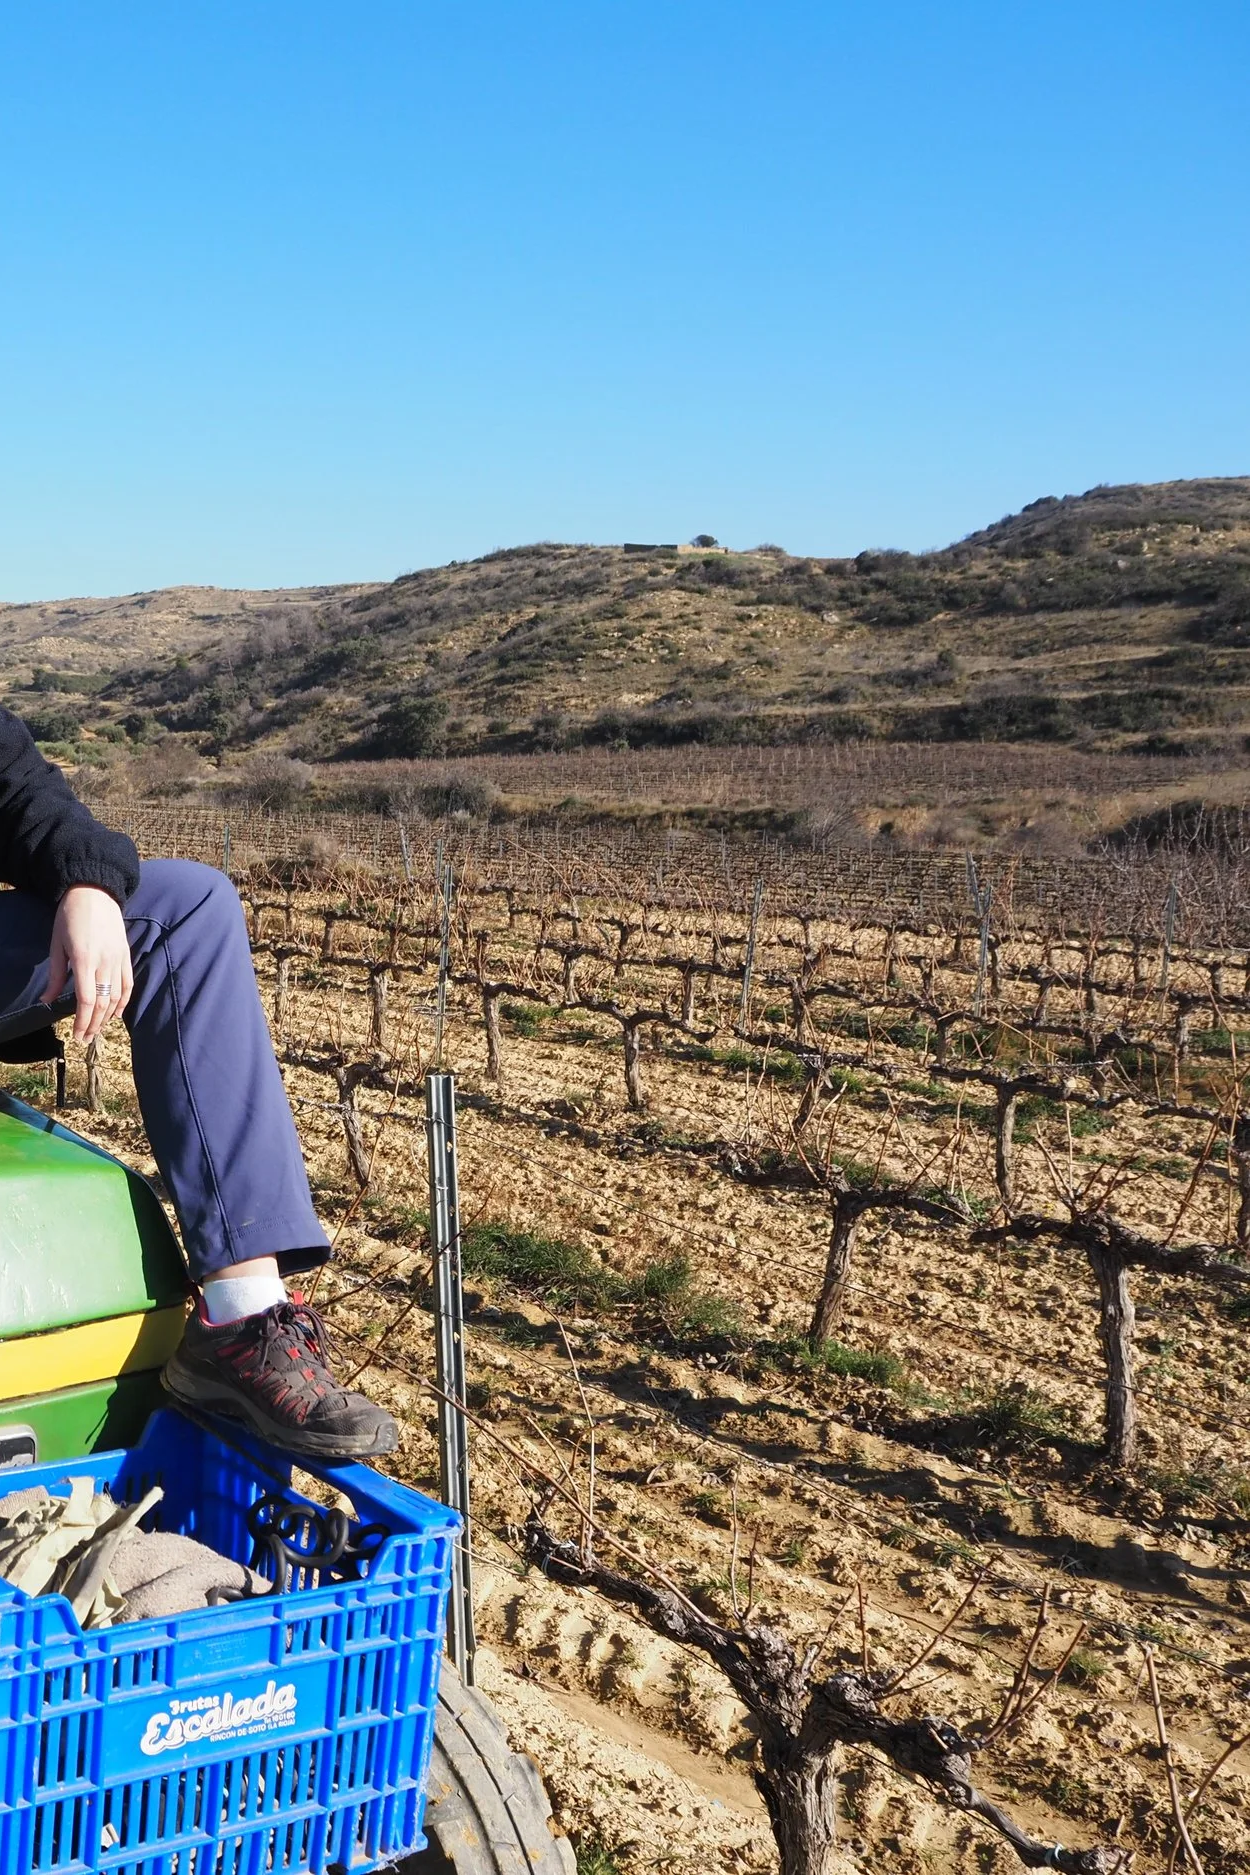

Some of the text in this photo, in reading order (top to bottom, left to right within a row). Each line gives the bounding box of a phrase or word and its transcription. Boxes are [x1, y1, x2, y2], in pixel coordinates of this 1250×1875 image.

[140, 1680, 298, 1755] Escalada
[210, 1730, 236, 1742] RINCON
[237, 1728, 247, 1737] DE
[248, 1723, 266, 1735] SOTO
